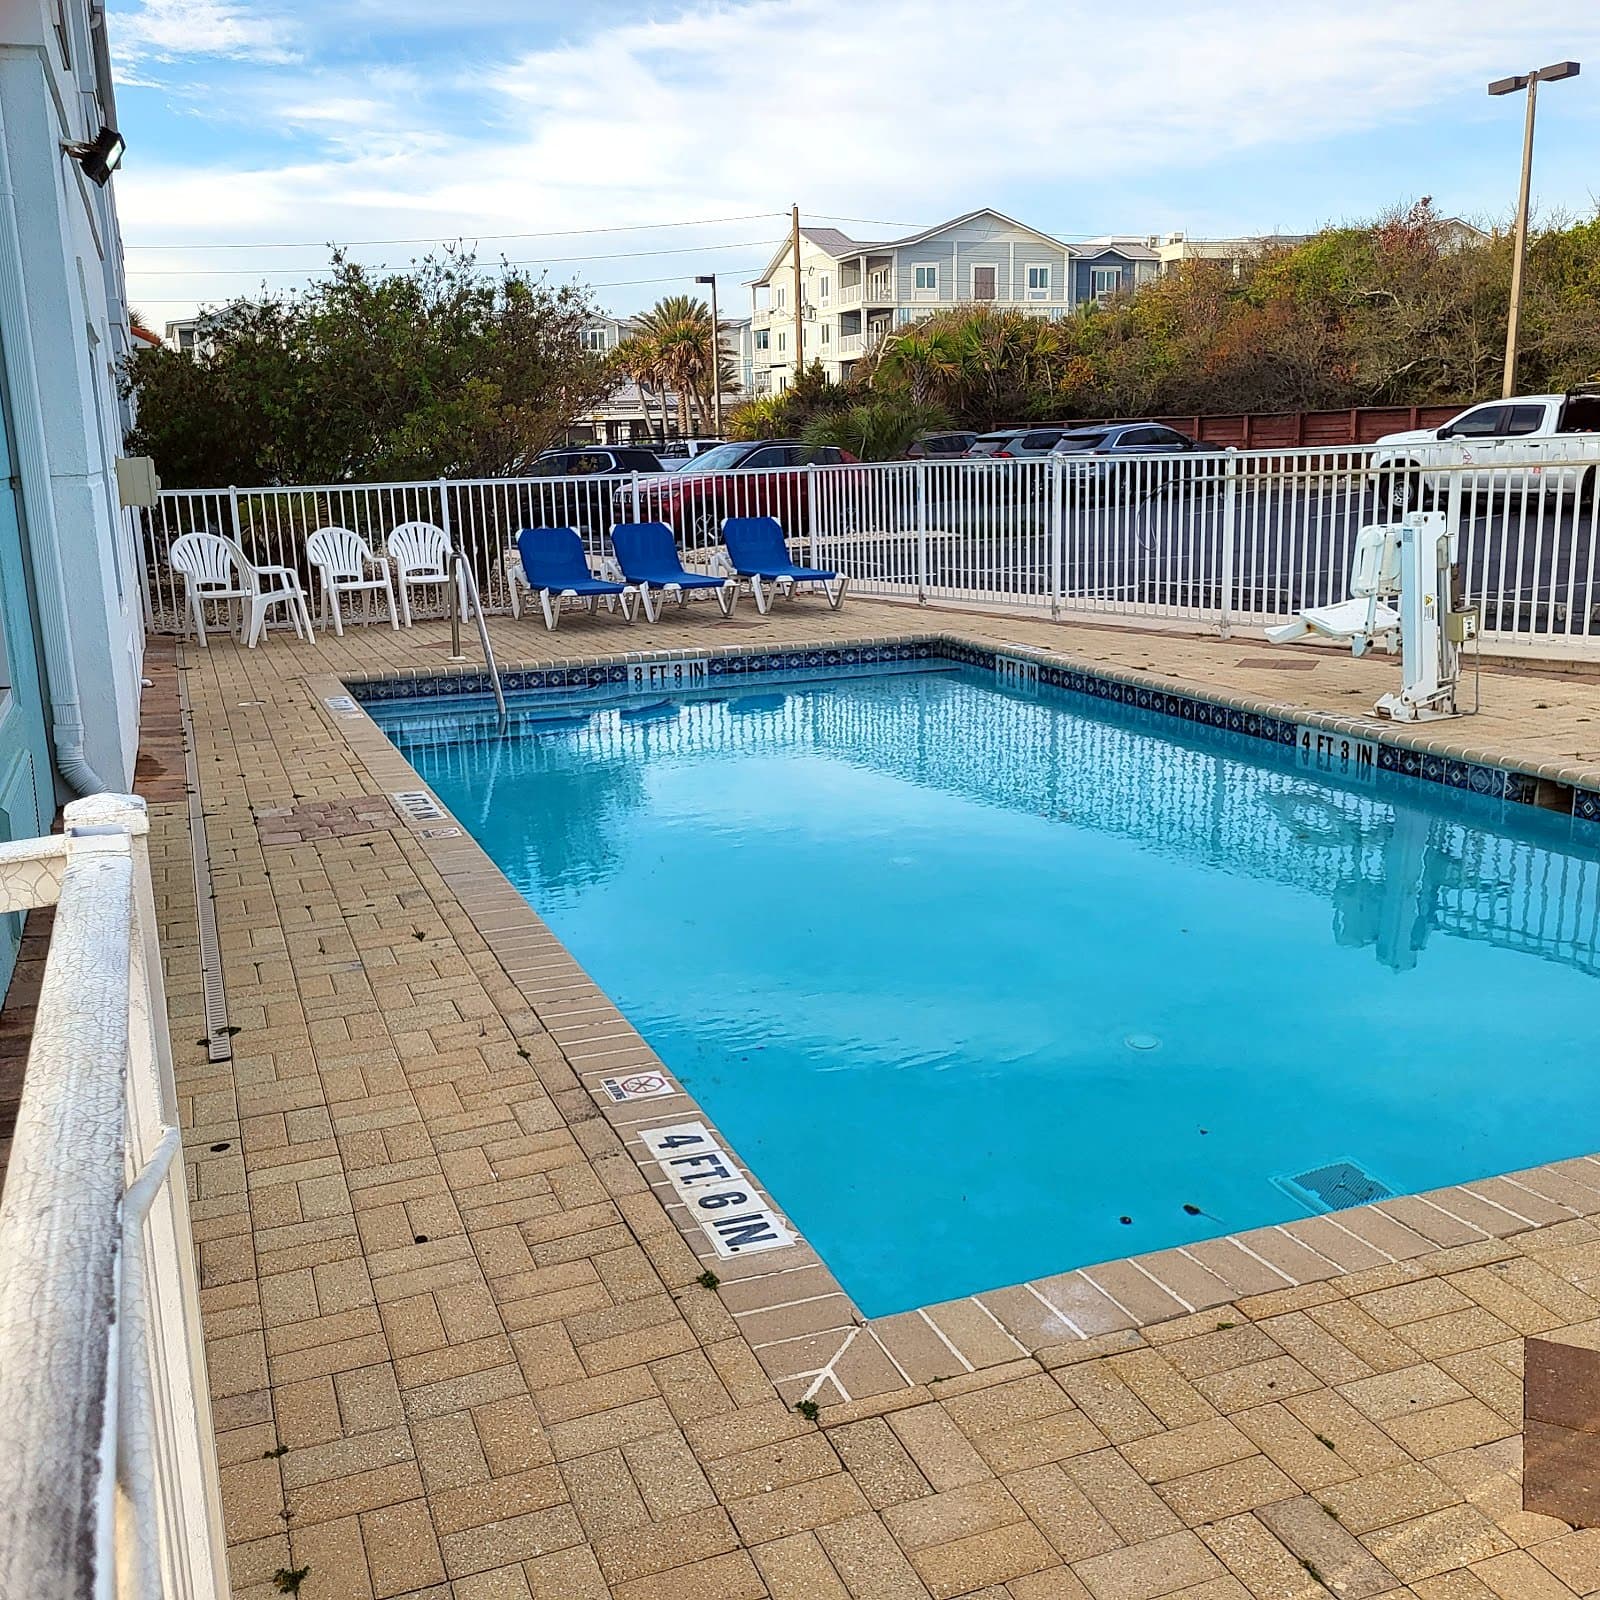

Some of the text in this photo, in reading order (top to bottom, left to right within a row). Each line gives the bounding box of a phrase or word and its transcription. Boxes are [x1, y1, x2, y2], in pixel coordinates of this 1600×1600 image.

[634, 667, 642, 680] 3
[674, 664, 682, 677] 3
[1302, 732, 1310, 750] 4
[1341, 741, 1349, 759] 3
[1357, 744, 1375, 767] IN.
[658, 1135, 778, 1252] 4 FT. 6 IN.
